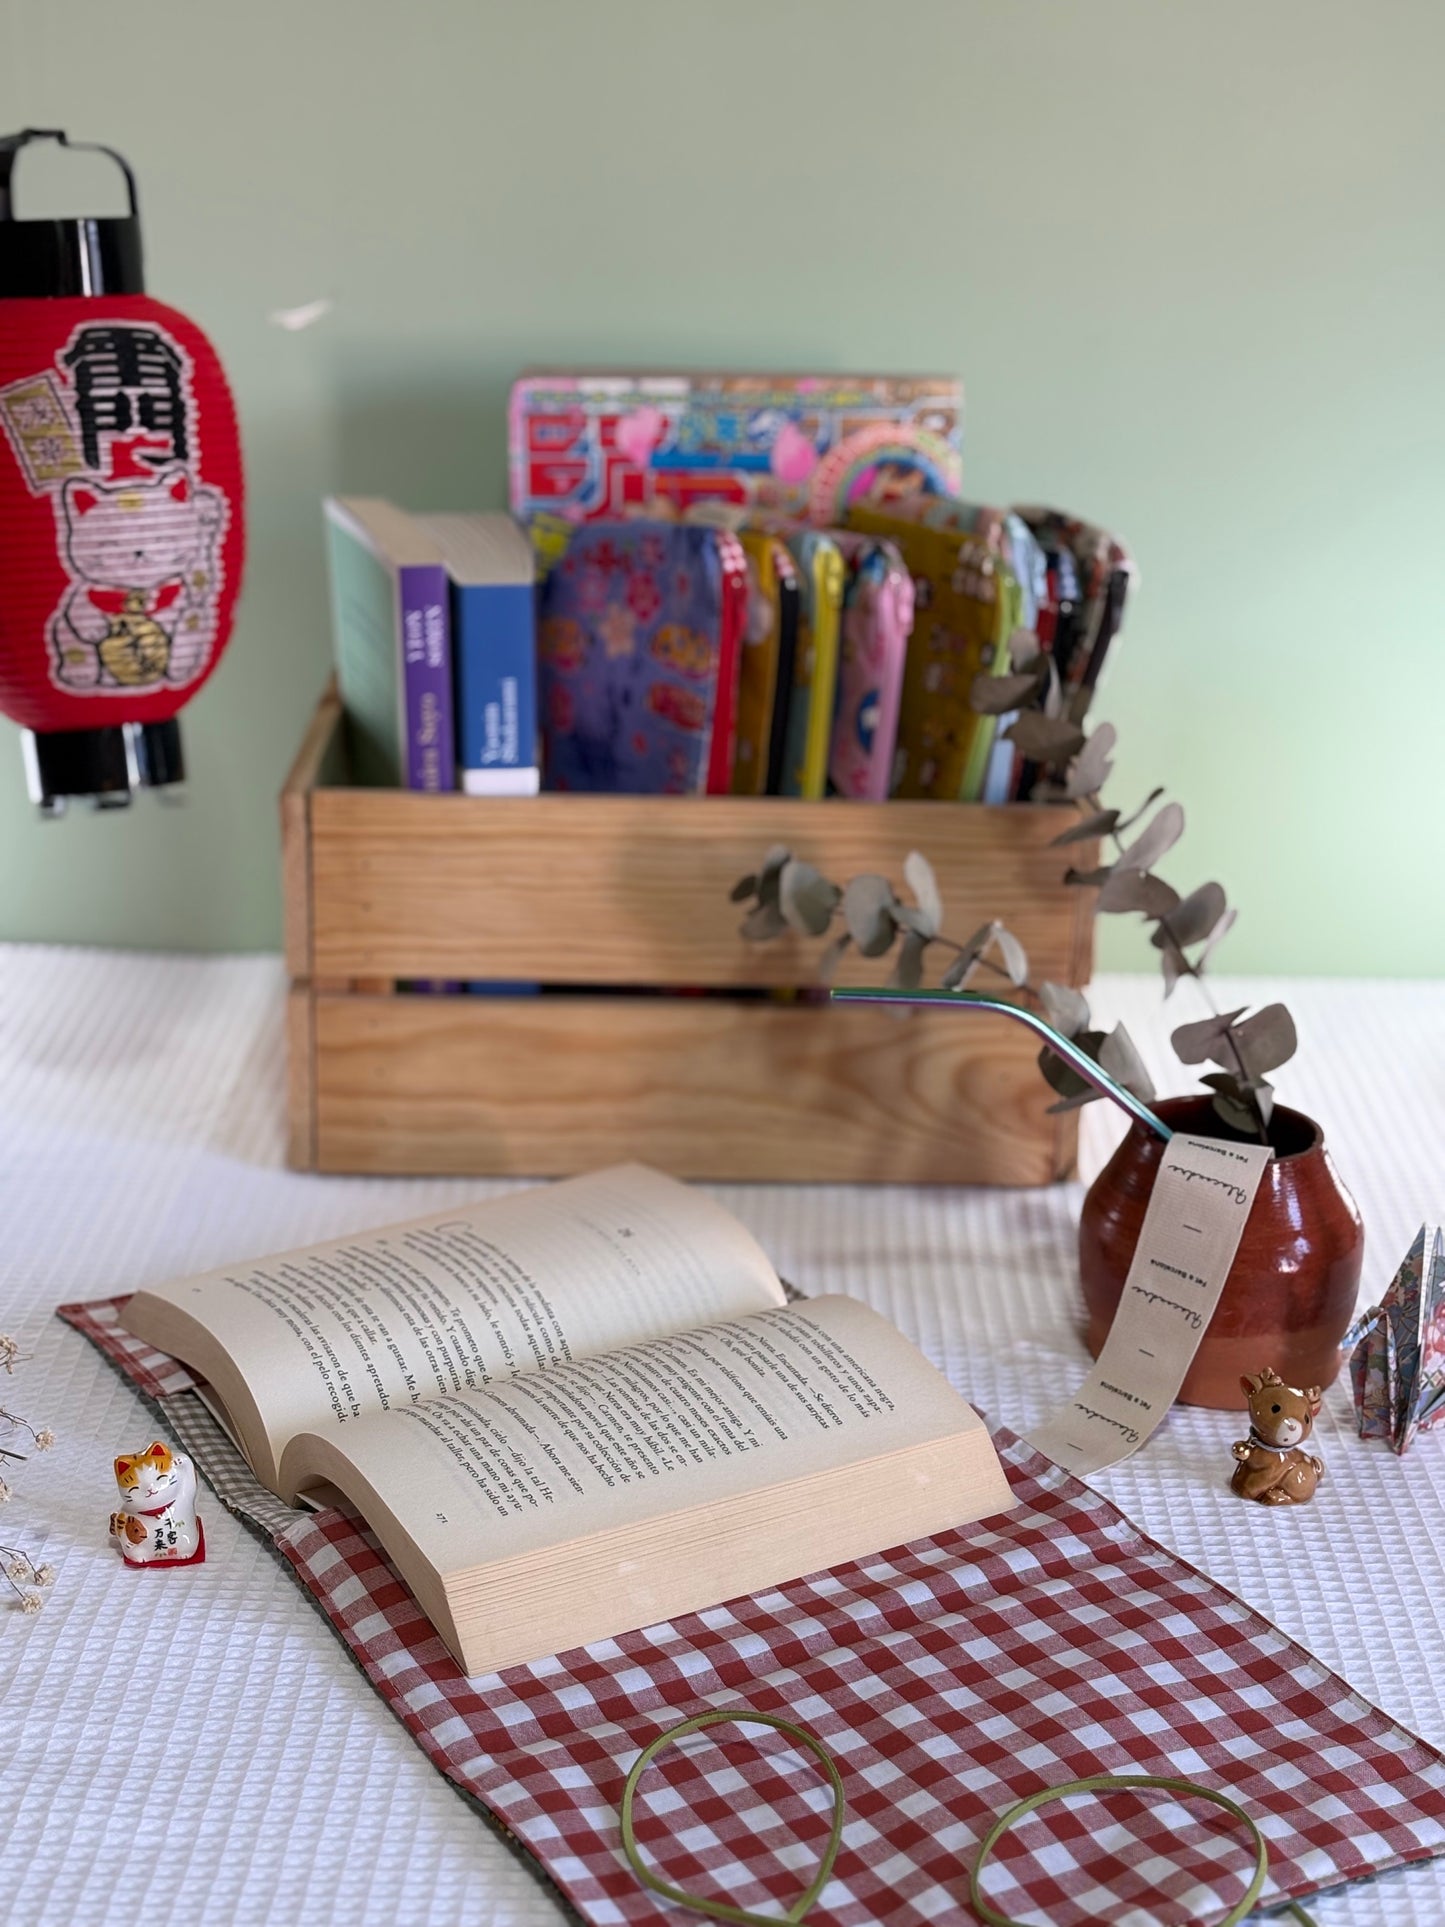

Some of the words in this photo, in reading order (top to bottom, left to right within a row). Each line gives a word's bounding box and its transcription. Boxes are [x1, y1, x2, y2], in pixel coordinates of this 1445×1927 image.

[1187, 1140, 1227, 1156] Barcelona
[1235, 1153, 1249, 1163] Fet
[1149, 1259, 1187, 1279] Barcelona
[1197, 1278, 1207, 1288] Fet
[431, 1330, 443, 1346] con
[490, 1320, 499, 1329] le
[495, 1330, 515, 1359] sonrió
[514, 1309, 531, 1332] todas
[540, 1327, 555, 1354] como
[552, 1320, 564, 1338] con
[301, 1337, 314, 1352] con
[312, 1360, 331, 1380] pelo
[317, 1336, 341, 1369] avisaron
[387, 1344, 408, 1373] gustar.
[404, 1374, 416, 1391] Me
[412, 1327, 424, 1336] de
[418, 1336, 429, 1349] las
[425, 1350, 440, 1373] otras
[450, 1335, 470, 1367] cuando
[453, 1318, 479, 1353] prometo
[474, 1355, 486, 1373] que
[744, 1356, 766, 1378] bonita.
[337, 1370, 349, 1382] de
[350, 1333, 371, 1362] dientes
[366, 1363, 390, 1411] apretados
[436, 1346, 462, 1392] purpurina
[751, 1350, 778, 1371] pasarle
[775, 1370, 789, 1383] una
[787, 1383, 798, 1392] de
[794, 1392, 808, 1403] sus
[805, 1403, 830, 1429] tarjetas
[774, 1353, 809, 1386] Encantada.
[821, 1403, 843, 1426] dieron
[798, 1343, 813, 1356] con
[811, 1355, 822, 1365] un
[818, 1365, 840, 1383] gesto
[838, 1384, 849, 1393] de
[846, 1393, 856, 1402] lo
[854, 1403, 870, 1418] más
[810, 1339, 844, 1369] tobilleros
[847, 1375, 865, 1393] unos
[863, 1394, 882, 1414] zapa-
[817, 1330, 832, 1342] con
[830, 1341, 845, 1354] una
[842, 1354, 877, 1388] americana
[874, 1388, 895, 1411] negra,
[1099, 1380, 1133, 1401] Barcelona
[342, 1383, 355, 1402] que
[676, 1376, 704, 1401] exigente
[701, 1401, 715, 1414] con
[718, 1422, 736, 1440] tema
[733, 1440, 750, 1452] del
[686, 1368, 698, 1377] Es
[695, 1377, 710, 1387] mi
[704, 1386, 726, 1406] mejor
[722, 1406, 743, 1429] amiga.
[748, 1437, 763, 1448] mi
[719, 1366, 746, 1391] teléfono
[742, 1391, 758, 1404] que
[754, 1404, 777, 1426] teníais
[774, 1426, 788, 1440] una
[1140, 1400, 1152, 1410] Fet
[470, 1427, 481, 1437] un
[542, 1390, 577, 1419] importante
[570, 1418, 589, 1430] por
[584, 1431, 595, 1440] su
[592, 1440, 622, 1473] colección
[619, 1473, 631, 1483] de
[554, 1384, 587, 1411] diseñadora
[584, 1410, 608, 1429] novel
[599, 1429, 615, 1442] que
[612, 1442, 627, 1456] este
[623, 1457, 638, 1470] año
[598, 1404, 624, 1434] Carmen,
[627, 1442, 660, 1475] presento
[602, 1391, 623, 1410] Nerea
[620, 1410, 632, 1421] era
[629, 1420, 647, 1435] muy
[643, 1435, 665, 1456] hábil.
[615, 1388, 643, 1412] sonrisas
[640, 1412, 651, 1421] de
[647, 1420, 660, 1431] las
[657, 1431, 672, 1445] dos
[668, 1445, 678, 1454] se
[676, 1454, 688, 1467] en-
[645, 1402, 664, 1414] por
[665, 1423, 682, 1437] que
[678, 1437, 692, 1448] me
[688, 1448, 703, 1463] han
[669, 1386, 691, 1407] cuatro
[688, 1407, 710, 1428] meses
[707, 1429, 732, 1455] exactos
[677, 1414, 695, 1428] casi
[689, 1428, 701, 1439] un
[698, 1440, 716, 1459] mila-
[475, 1436, 494, 1451] par
[490, 1428, 508, 1444] cielo
[507, 1445, 526, 1467] —dijo
[523, 1467, 534, 1476] la
[530, 1476, 546, 1487] tal
[539, 1487, 554, 1503] He-
[539, 1403, 560, 1421] suerte
[557, 1420, 569, 1429] de
[563, 1429, 579, 1442] que
[576, 1442, 590, 1455] nos
[586, 1454, 598, 1465] ha
[594, 1464, 615, 1487] hecho
[446, 1443, 465, 1462] taller,
[459, 1461, 479, 1478] pero
[476, 1477, 487, 1489] ha
[484, 1489, 501, 1505] sido
[497, 1505, 509, 1516] un
[453, 1430, 473, 1446] echar
[469, 1447, 483, 1461] una
[480, 1461, 501, 1481] mano
[497, 1482, 510, 1493] mi
[506, 1494, 523, 1512] ayu-
[497, 1458, 517, 1478] cosas
[511, 1478, 528, 1493] que
[539, 1443, 561, 1465] Ahora
[558, 1465, 571, 1477] me
[567, 1477, 584, 1495] sien-
[522, 1493, 538, 1507] po-
[154, 1528, 168, 1551] 万来
[165, 1518, 178, 1545] 千客
